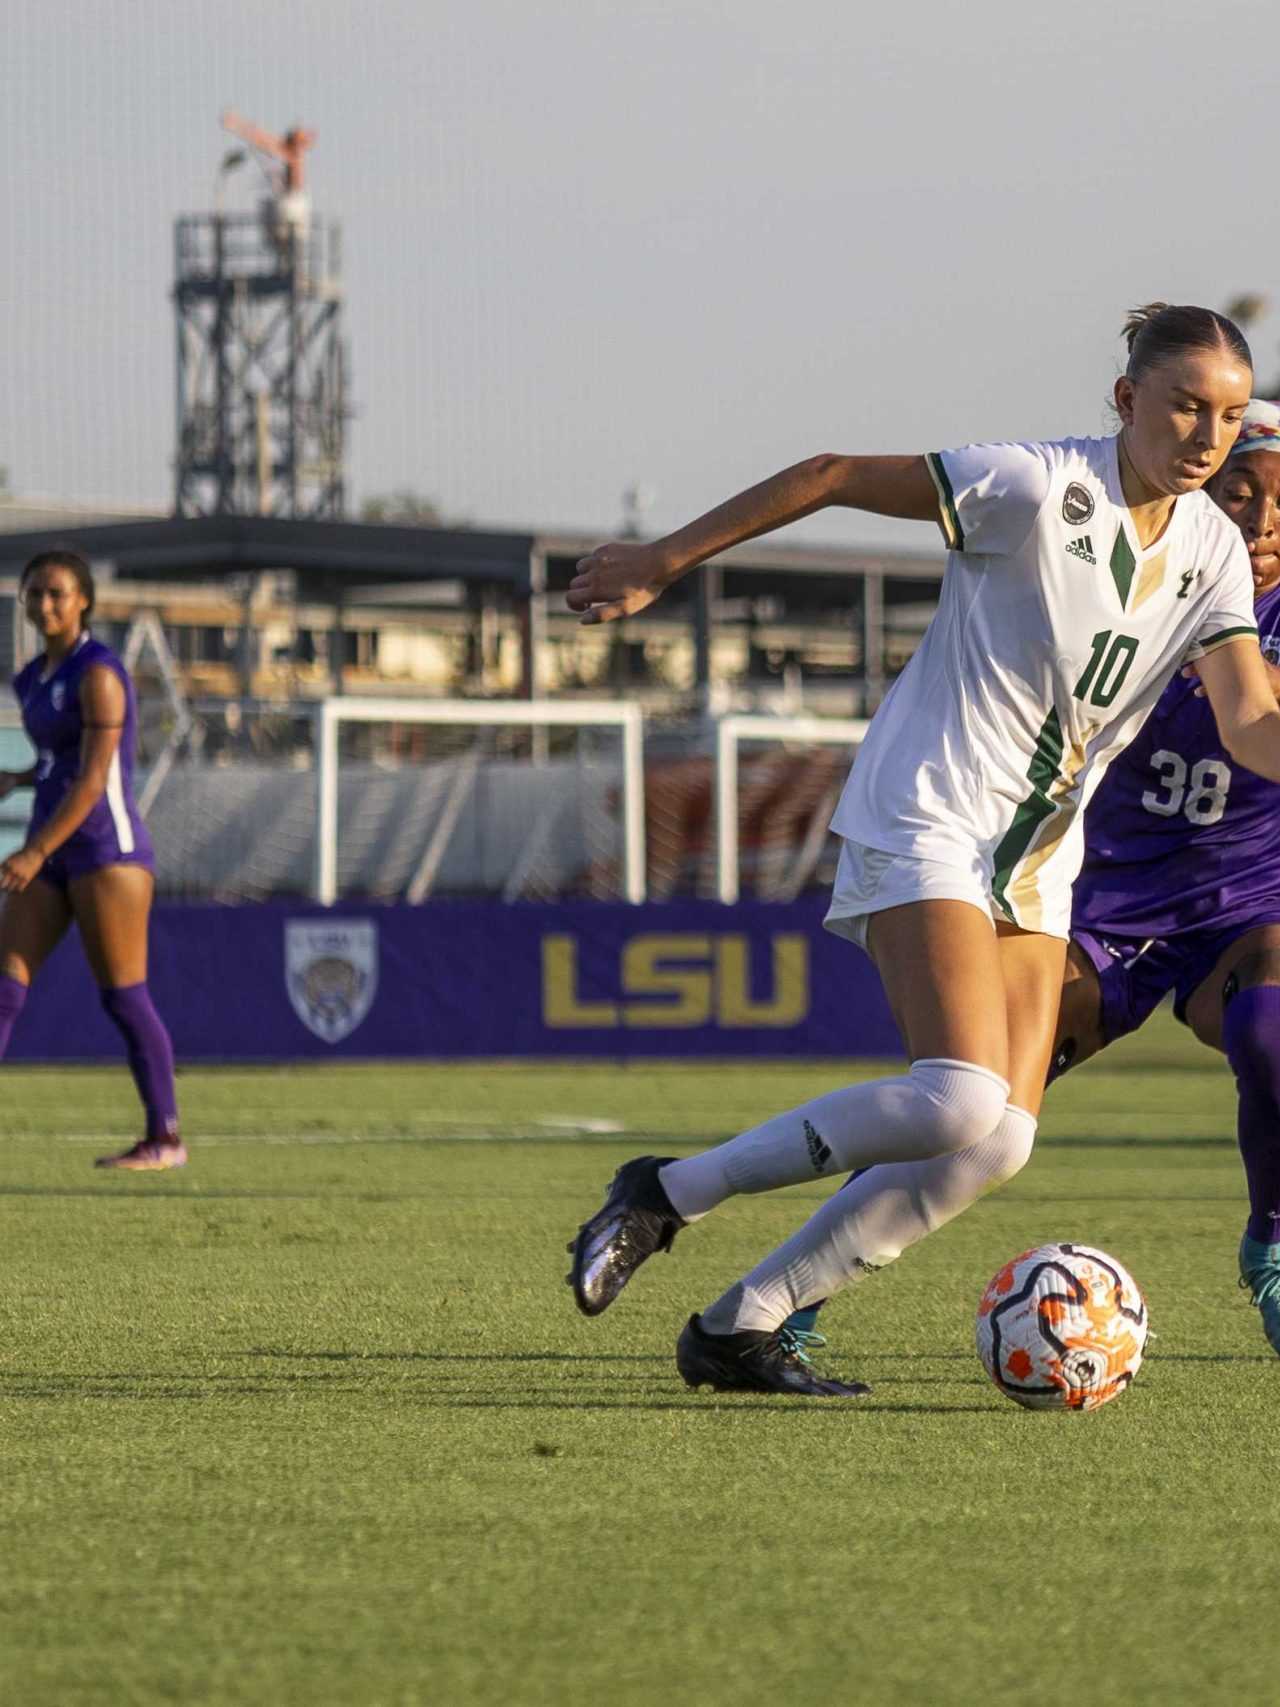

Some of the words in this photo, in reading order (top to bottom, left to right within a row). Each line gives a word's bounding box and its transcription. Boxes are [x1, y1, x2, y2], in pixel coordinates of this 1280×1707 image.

[1065, 544, 1097, 565] adidas
[1072, 629, 1140, 708] 10
[1141, 748, 1232, 825] 38
[541, 932, 811, 1029] LSU
